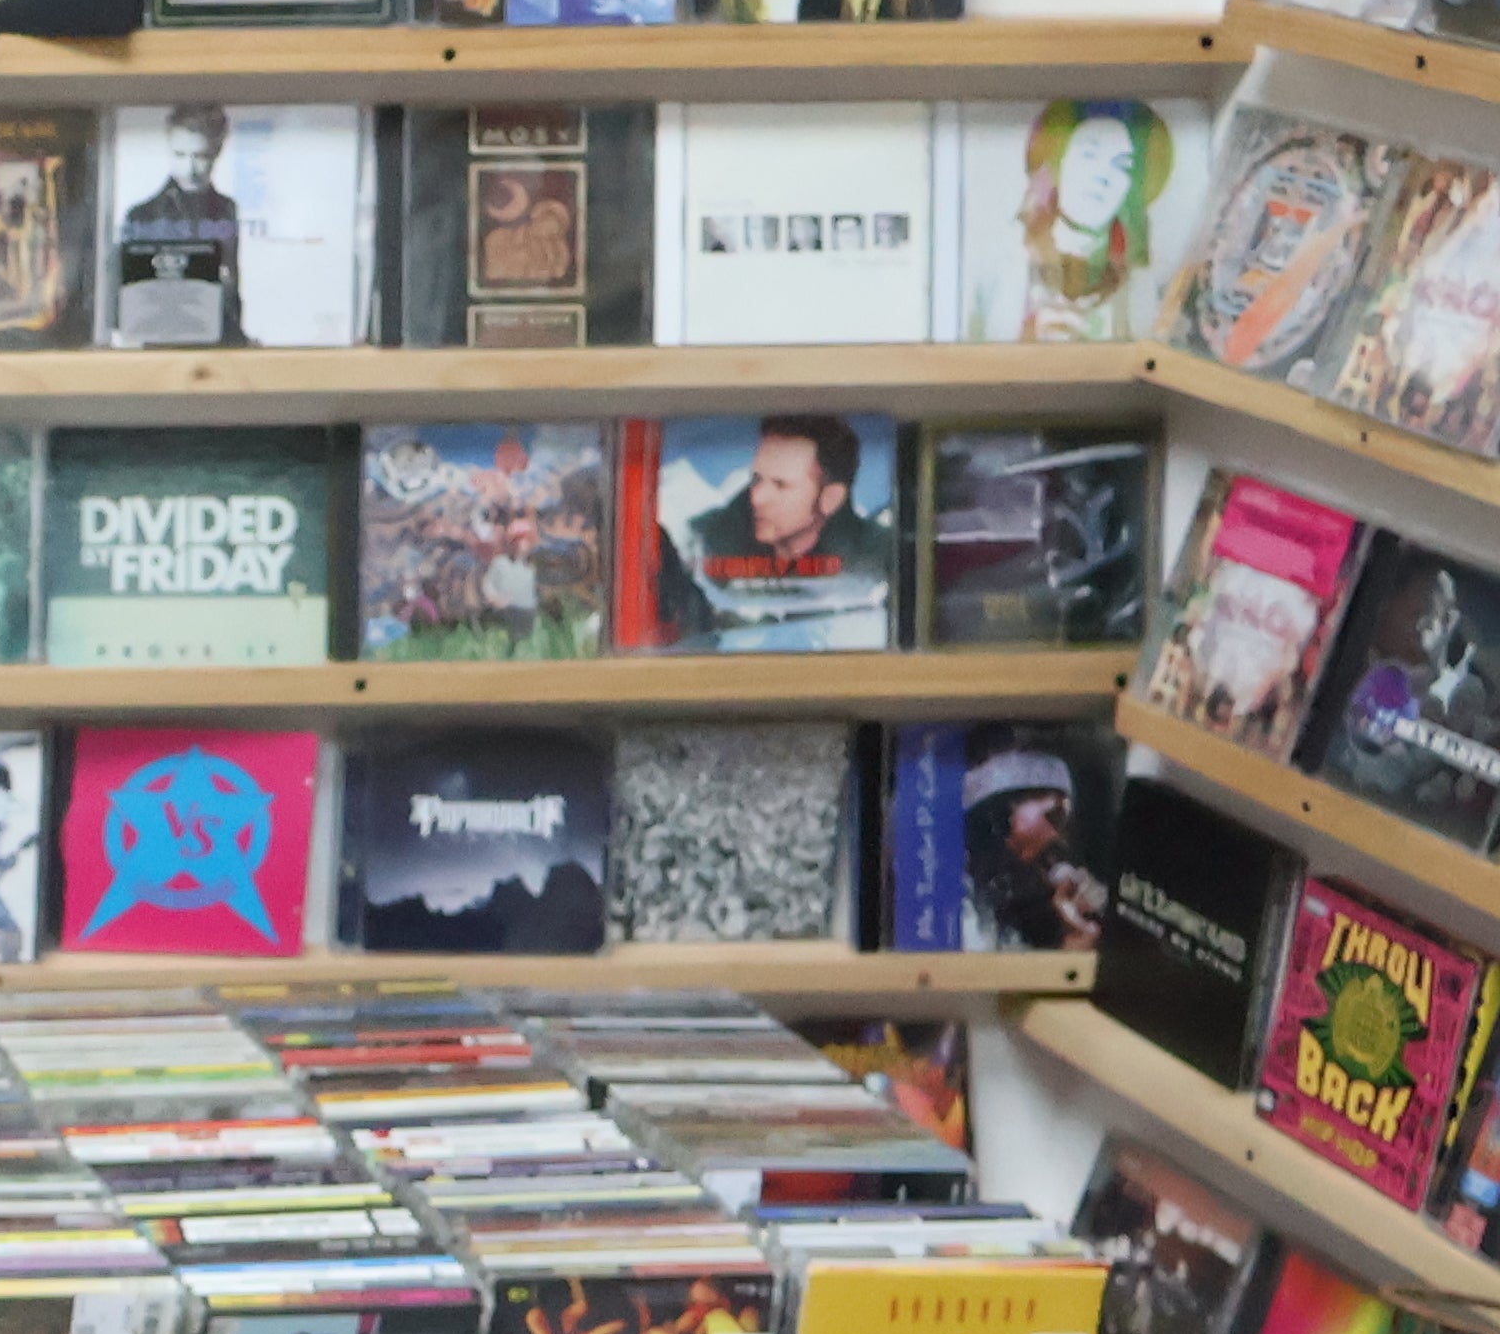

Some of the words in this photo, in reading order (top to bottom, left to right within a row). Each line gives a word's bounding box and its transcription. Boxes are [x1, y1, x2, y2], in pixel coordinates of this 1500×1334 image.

[80, 495, 298, 548] DIVIDED
[110, 546, 296, 595] FRIDAY
[1322, 911, 1435, 1024] THROW
[1296, 1025, 1414, 1143] BACK
